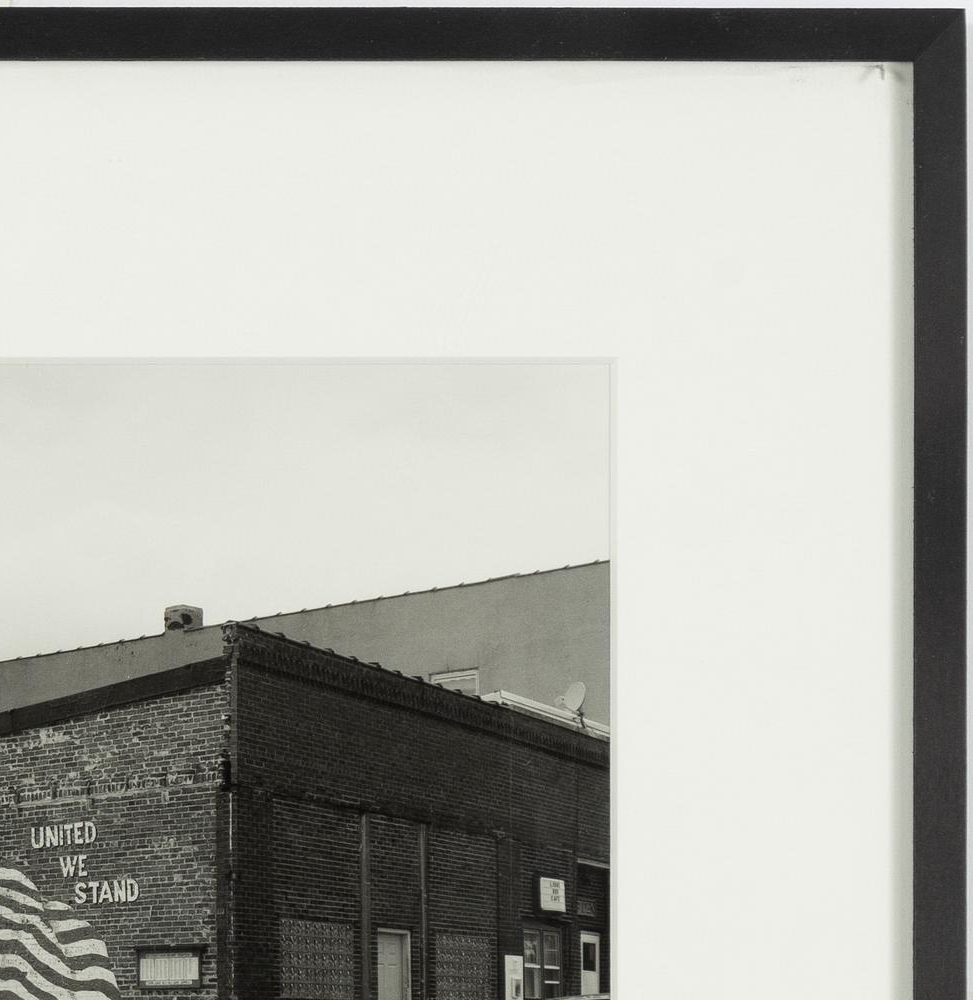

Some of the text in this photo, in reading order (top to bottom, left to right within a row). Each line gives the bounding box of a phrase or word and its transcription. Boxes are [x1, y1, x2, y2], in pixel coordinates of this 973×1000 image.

[31, 821, 97, 849] UNITED
[59, 855, 88, 877] WE
[74, 879, 139, 904] STAND
